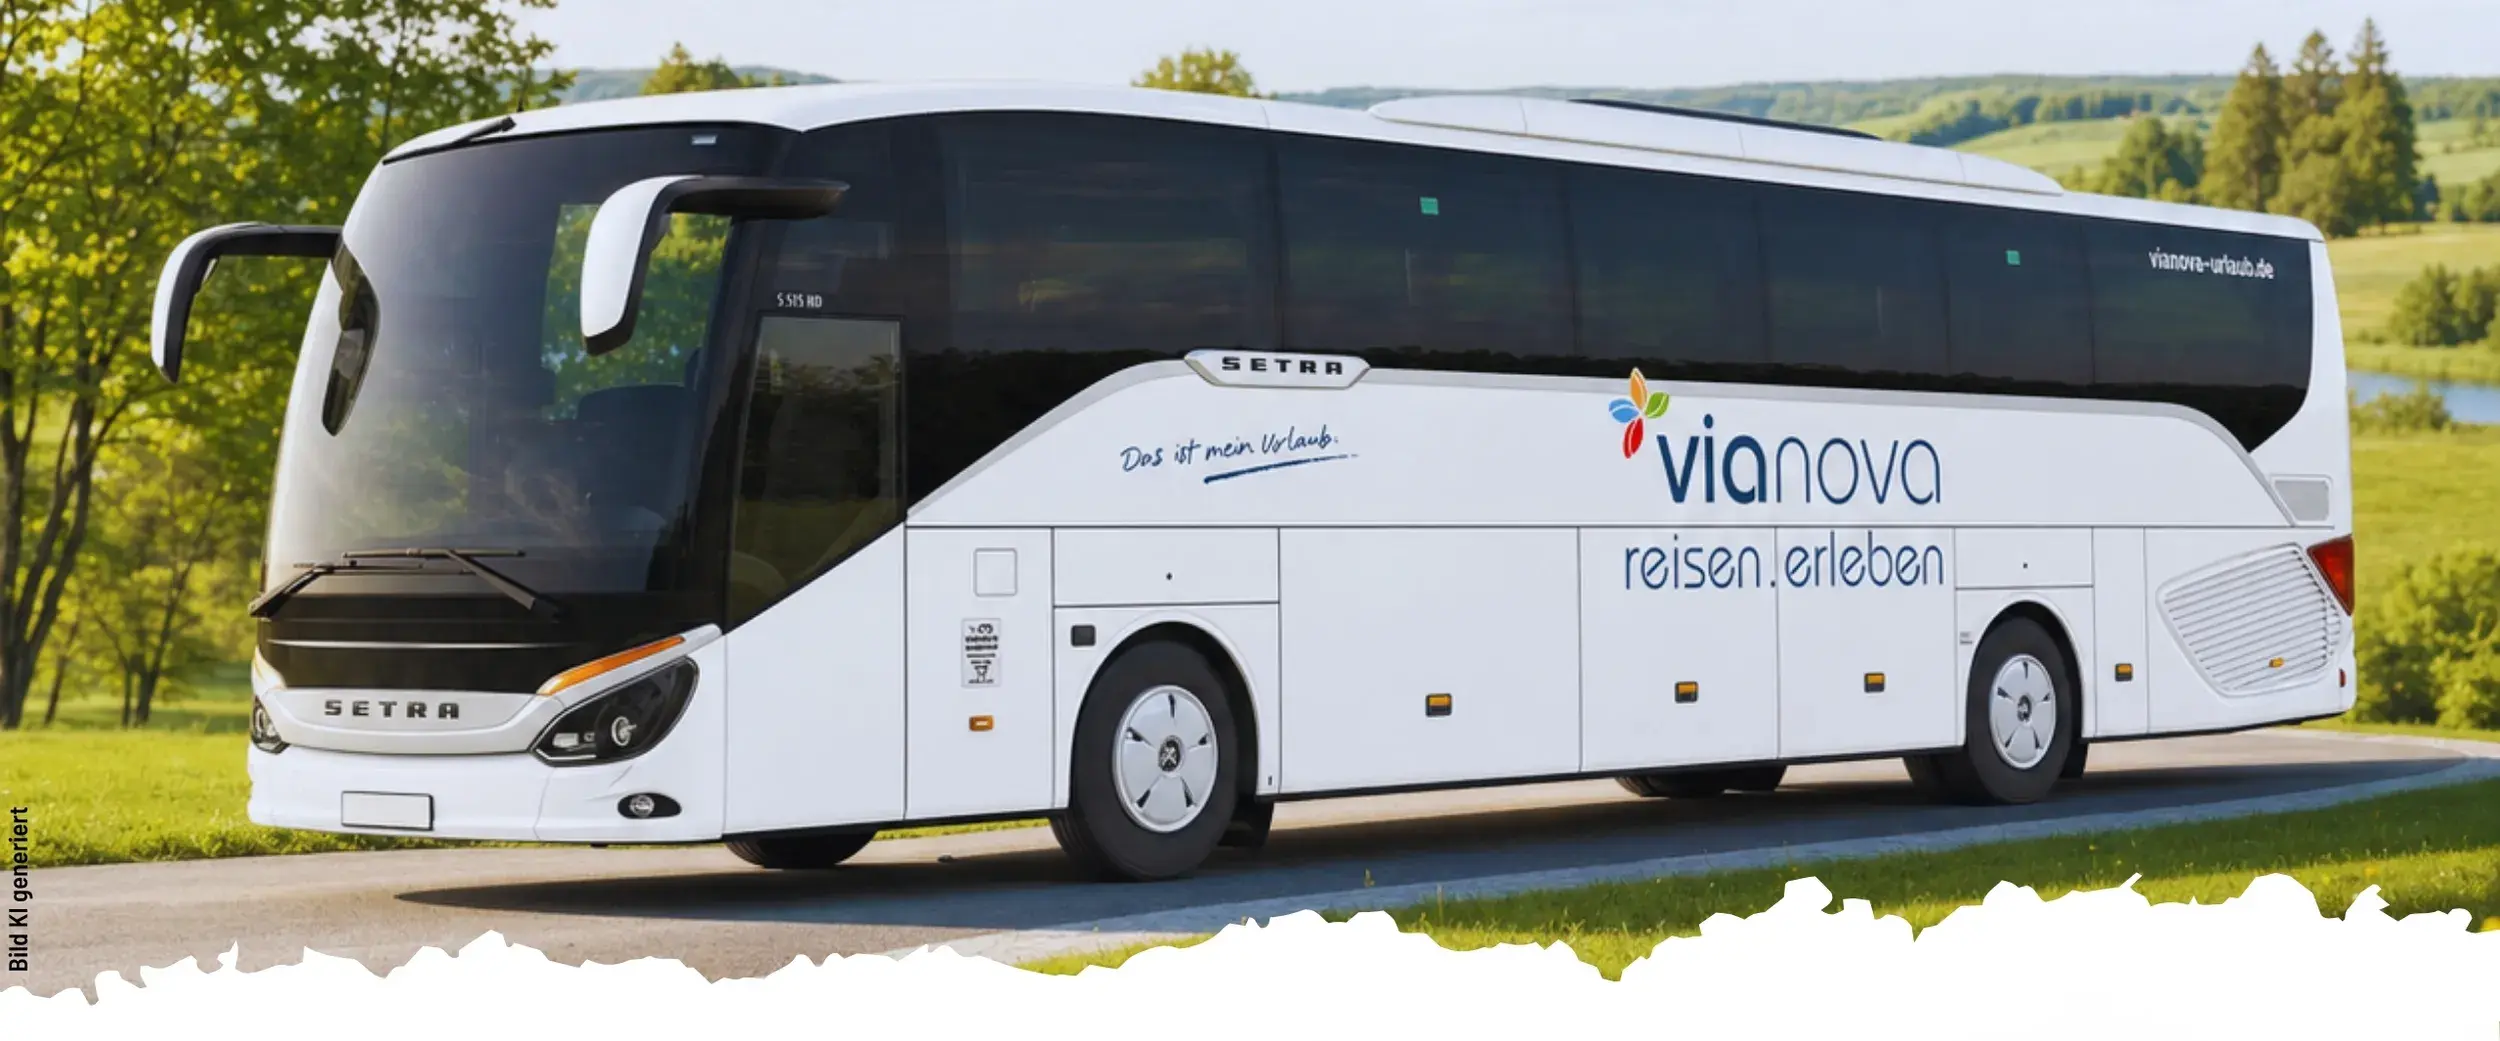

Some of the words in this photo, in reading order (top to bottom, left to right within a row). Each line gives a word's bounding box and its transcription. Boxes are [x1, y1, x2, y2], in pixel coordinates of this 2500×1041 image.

[1221, 356, 1343, 375] SETRA
[1173, 438, 1201, 464] ist
[1205, 436, 1254, 461] mein
[1656, 413, 1941, 504] vianova
[324, 700, 459, 719] SETRA
